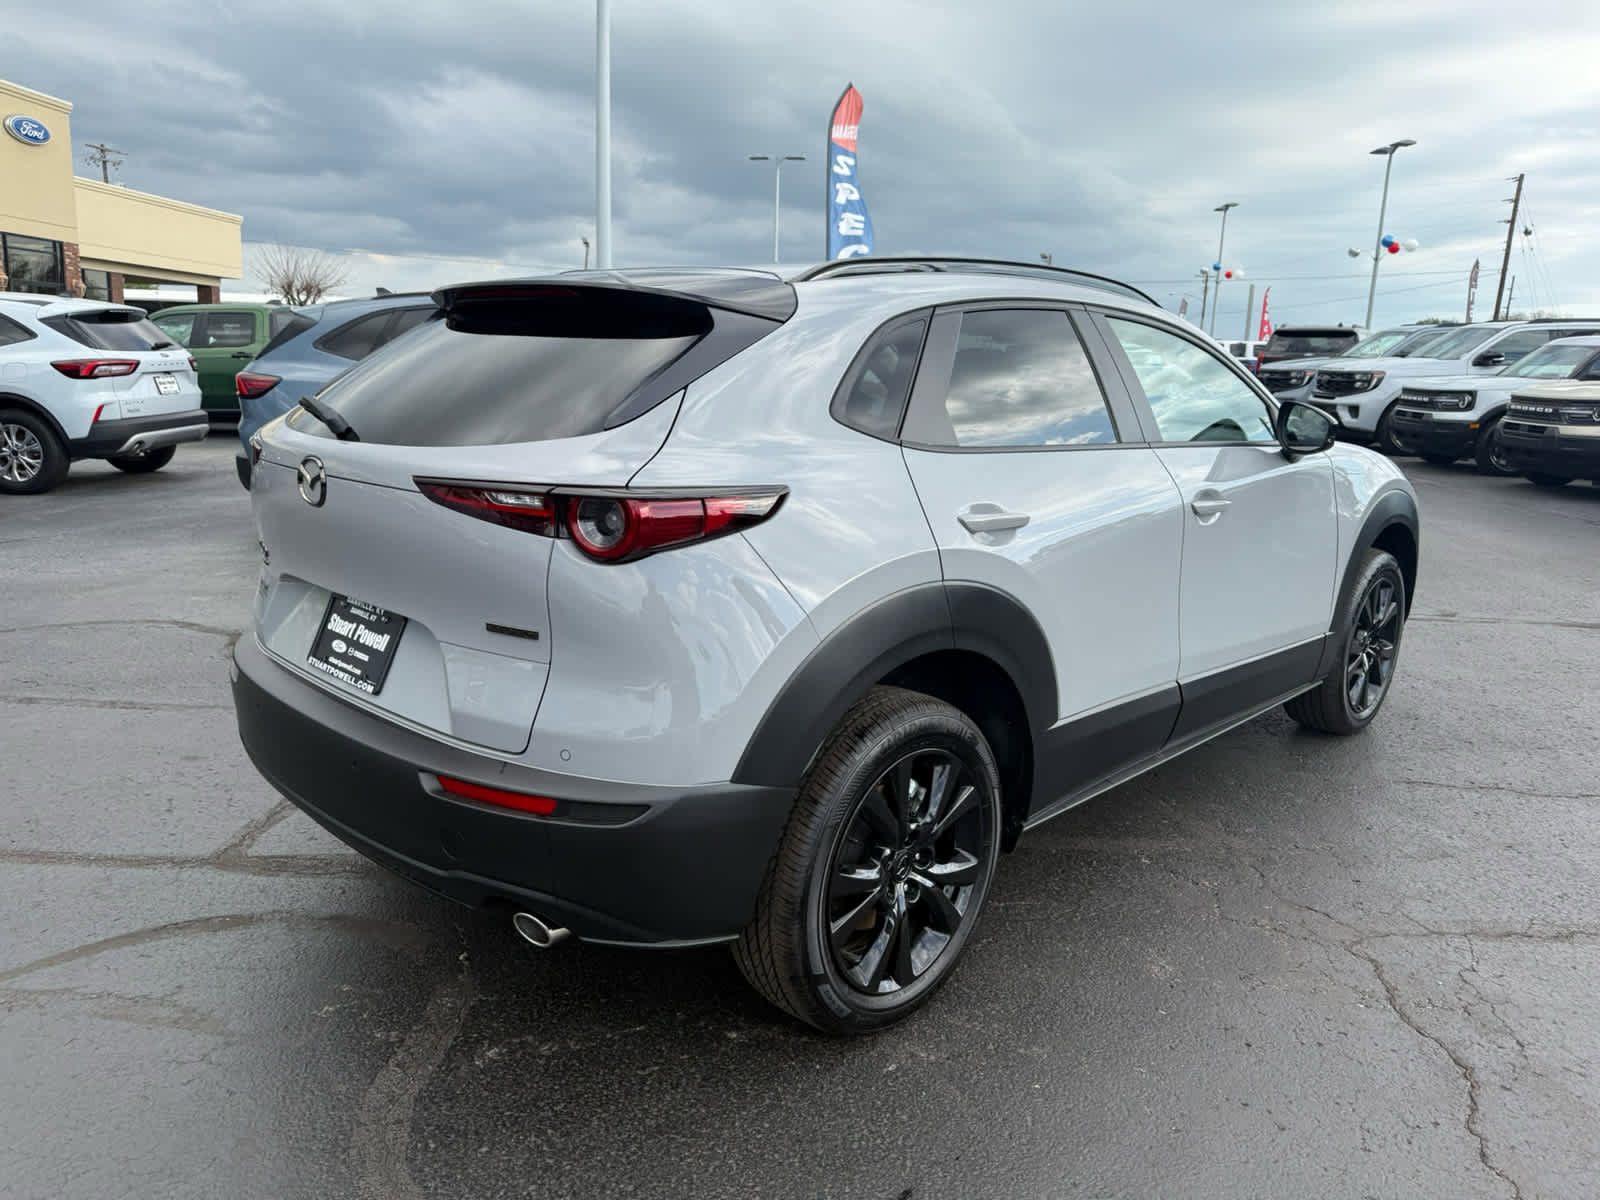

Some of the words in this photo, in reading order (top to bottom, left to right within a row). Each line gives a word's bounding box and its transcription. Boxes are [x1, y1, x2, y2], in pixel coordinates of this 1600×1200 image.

[20, 121, 45, 140] Ford
[1510, 404, 1553, 413] BRONCO
[327, 613, 357, 638] Stuart
[353, 624, 391, 652] Powell
[308, 656, 374, 694] STUARTPOWELL.COM
